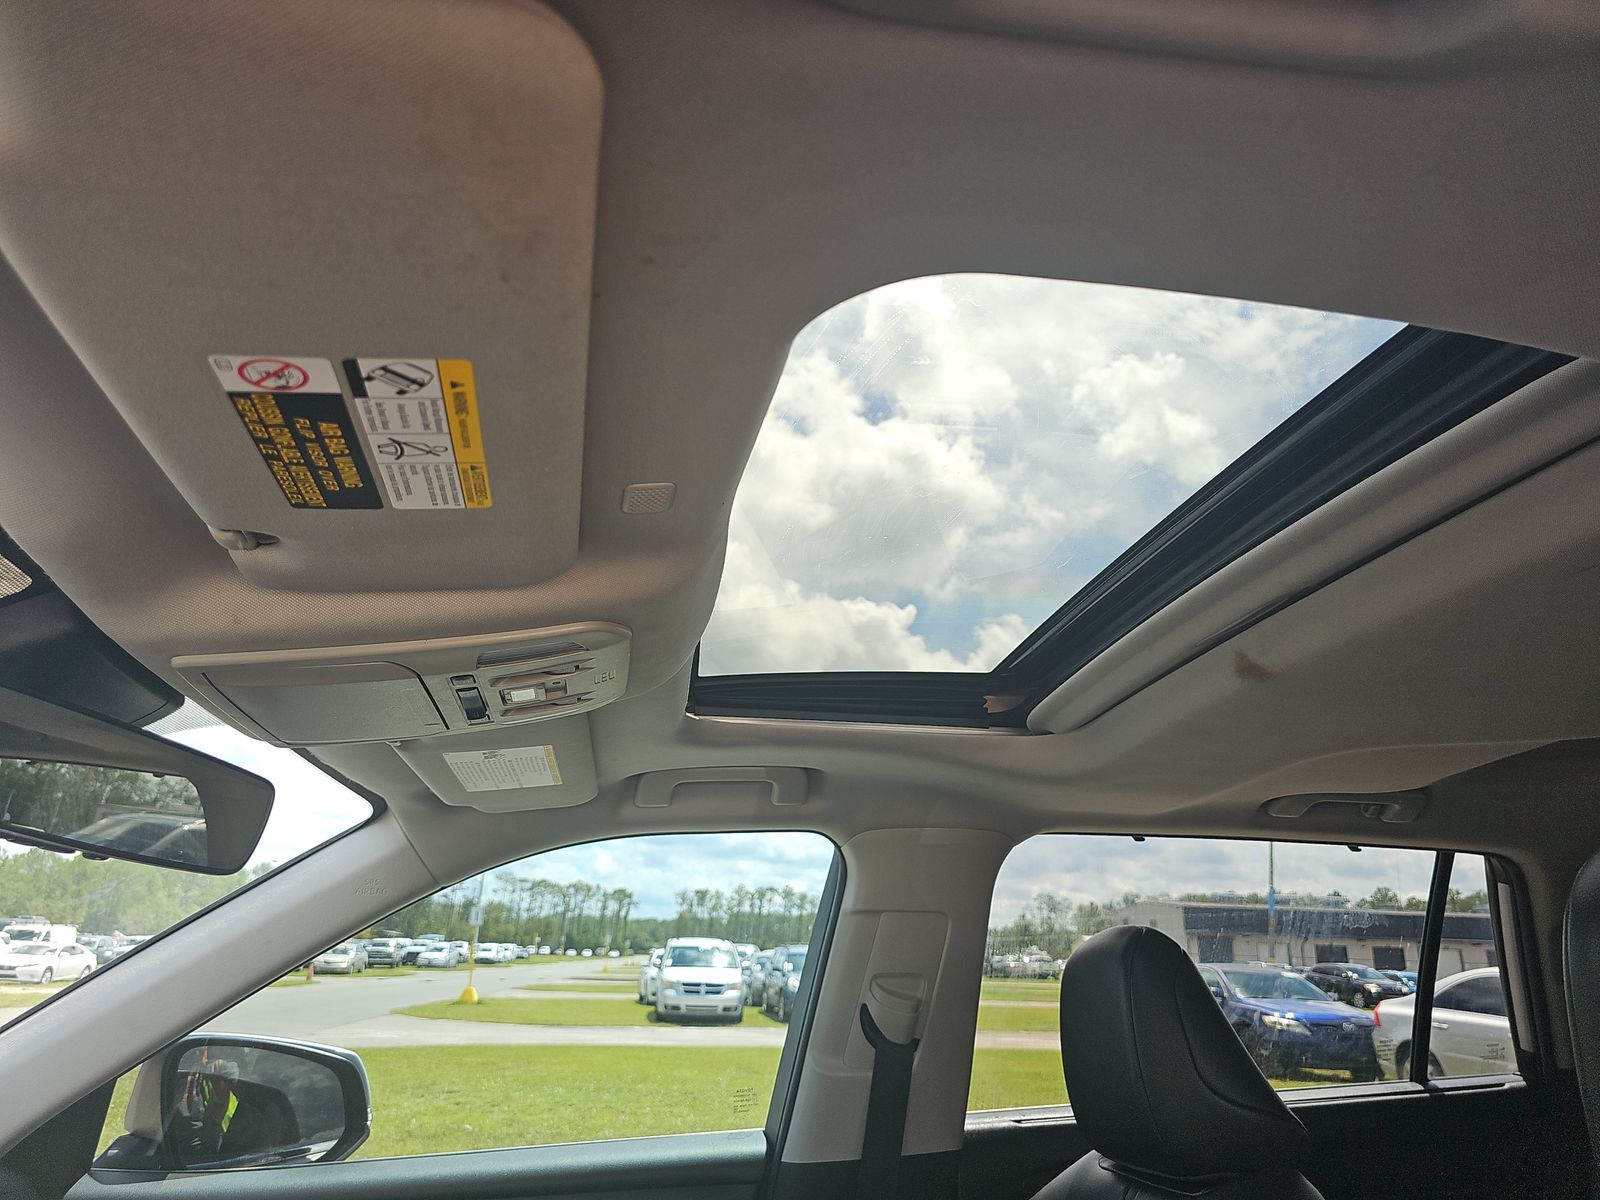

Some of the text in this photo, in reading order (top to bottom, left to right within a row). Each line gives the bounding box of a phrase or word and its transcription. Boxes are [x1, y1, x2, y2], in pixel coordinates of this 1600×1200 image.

[258, 444, 278, 454] LE
[294, 418, 340, 490] FLIP VISOR OVER
[319, 422, 364, 487] AIR BAG WARNING
